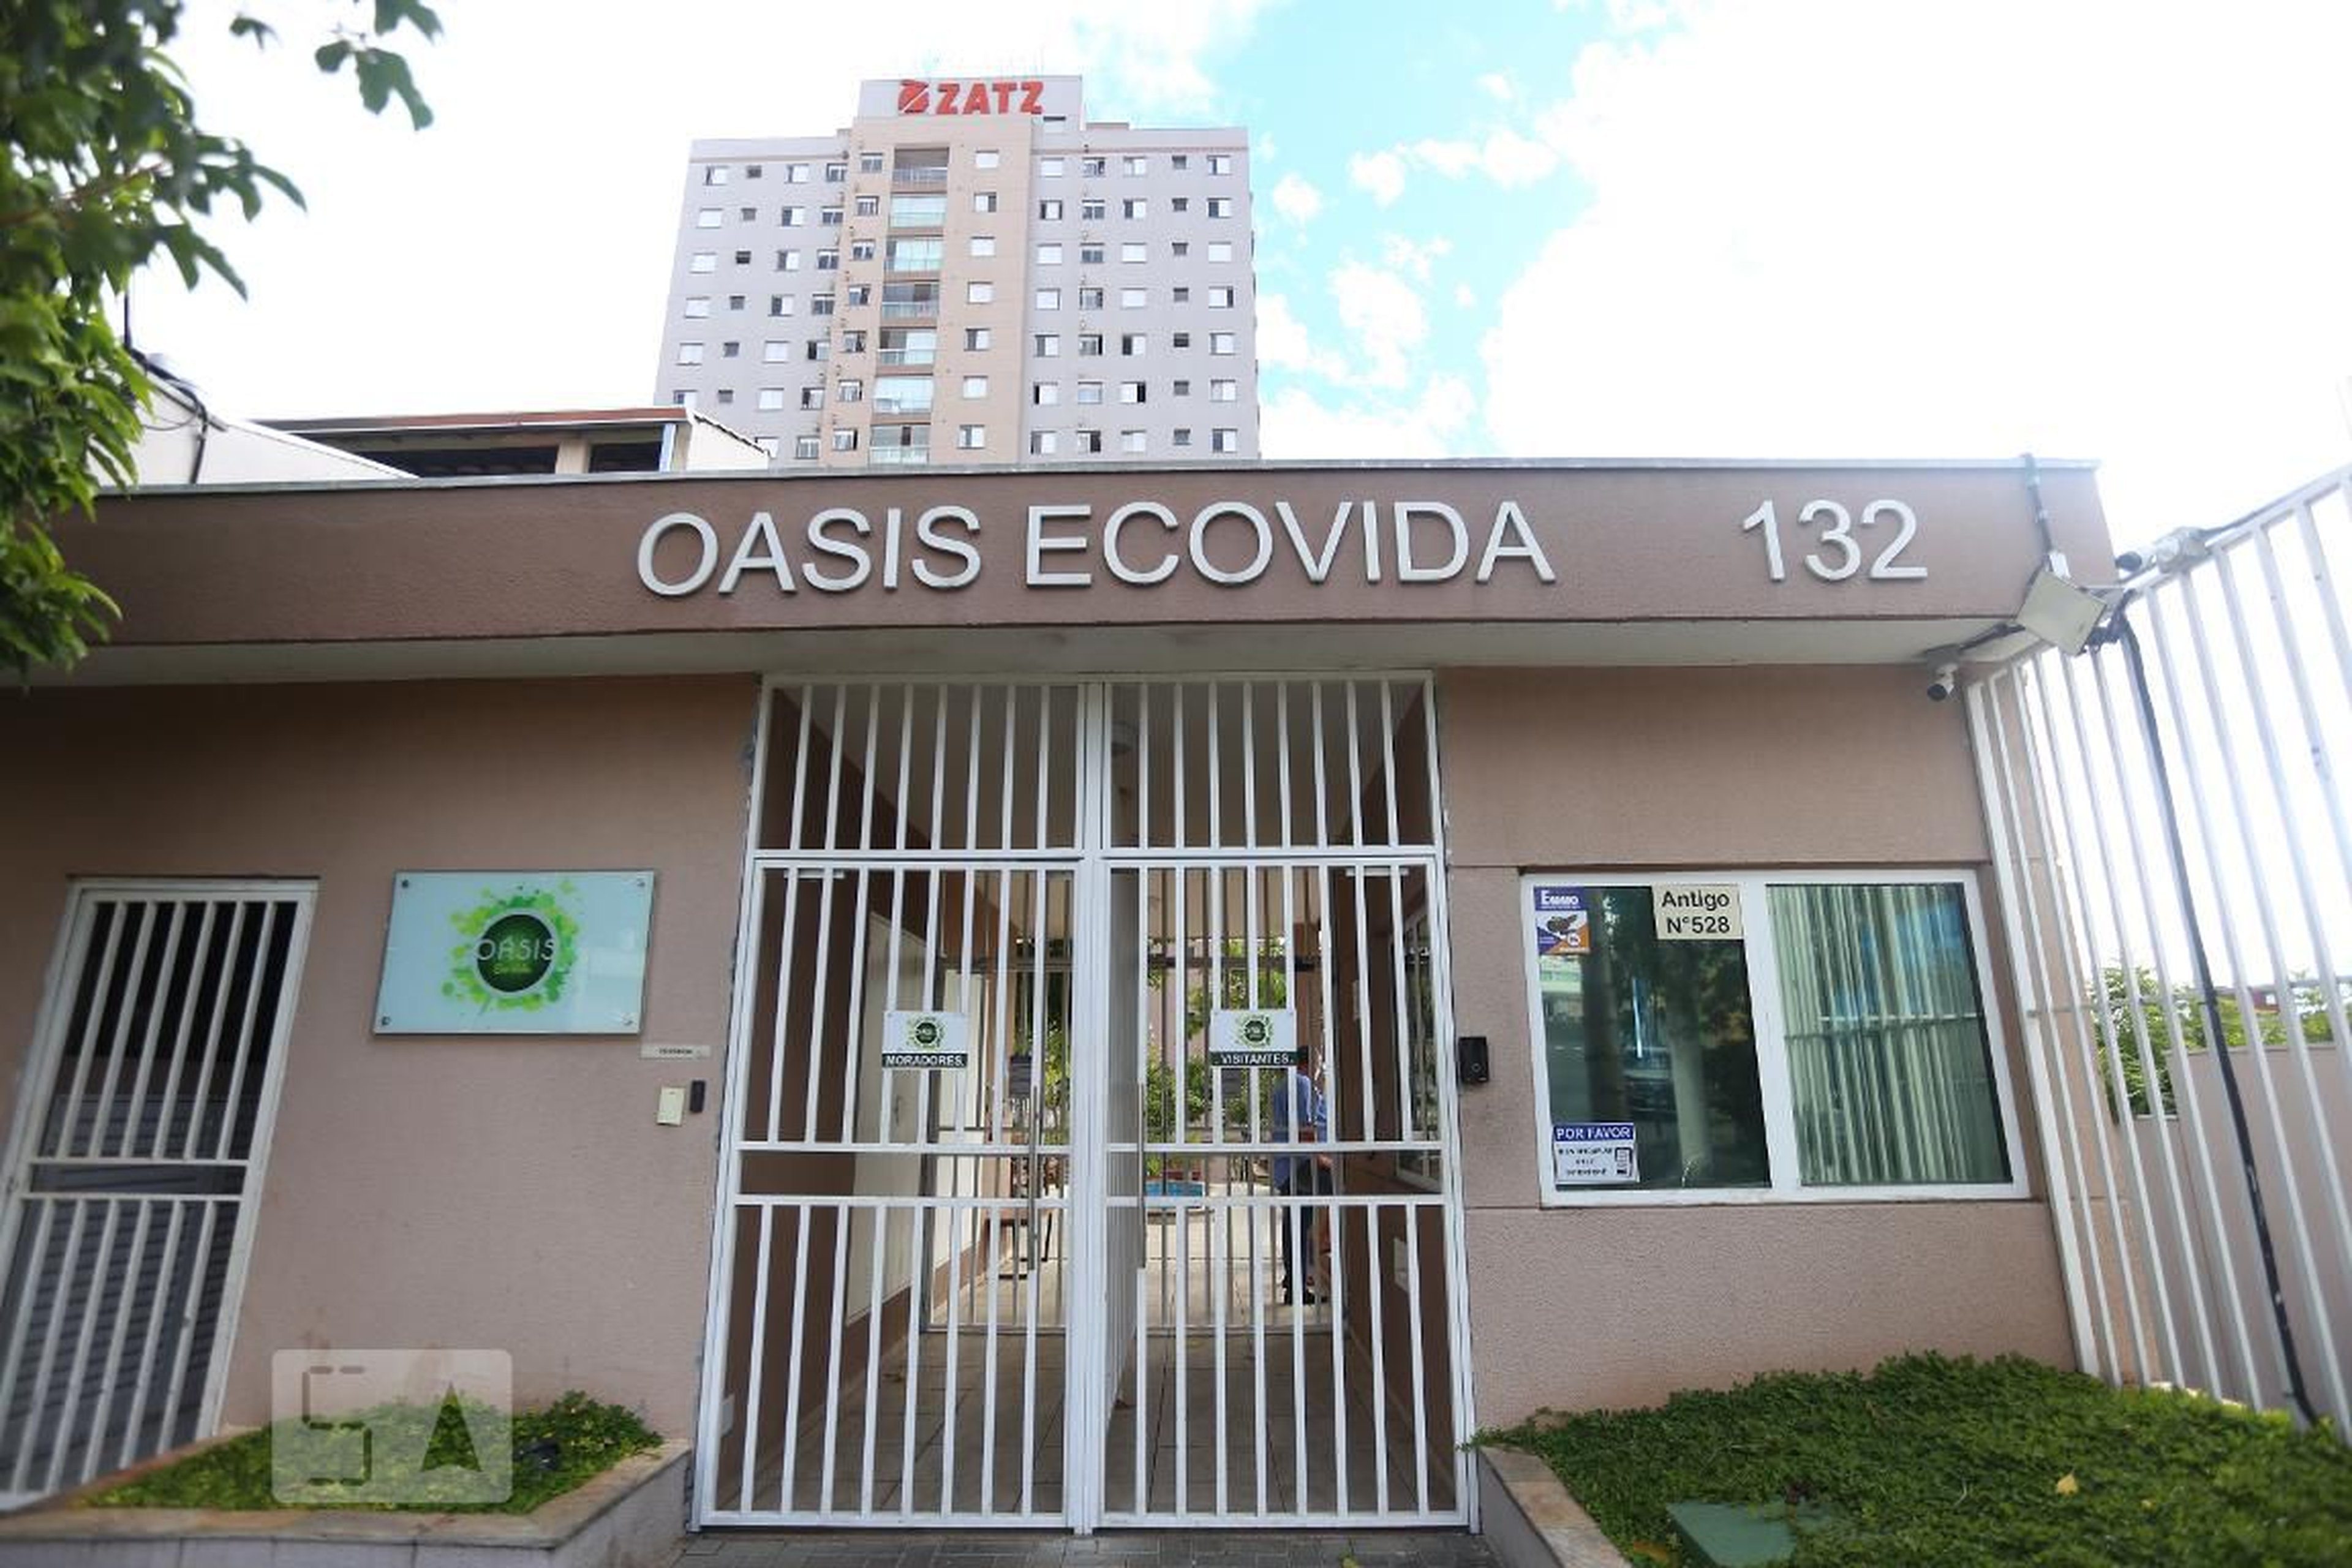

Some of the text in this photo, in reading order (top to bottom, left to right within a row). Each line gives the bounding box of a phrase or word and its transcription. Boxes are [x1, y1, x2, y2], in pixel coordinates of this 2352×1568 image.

[936, 81, 1044, 115] ZATZ
[638, 500, 1556, 595] OASIS ECOVIDA
[1743, 499, 1928, 581] 132
[1662, 890, 1730, 911] Antigo
[475, 937, 555, 960] OASIS
[886, 1055, 962, 1066] MORADORES
[1221, 1053, 1289, 1064] VISITANTES
[1556, 1128, 1584, 1139] POR
